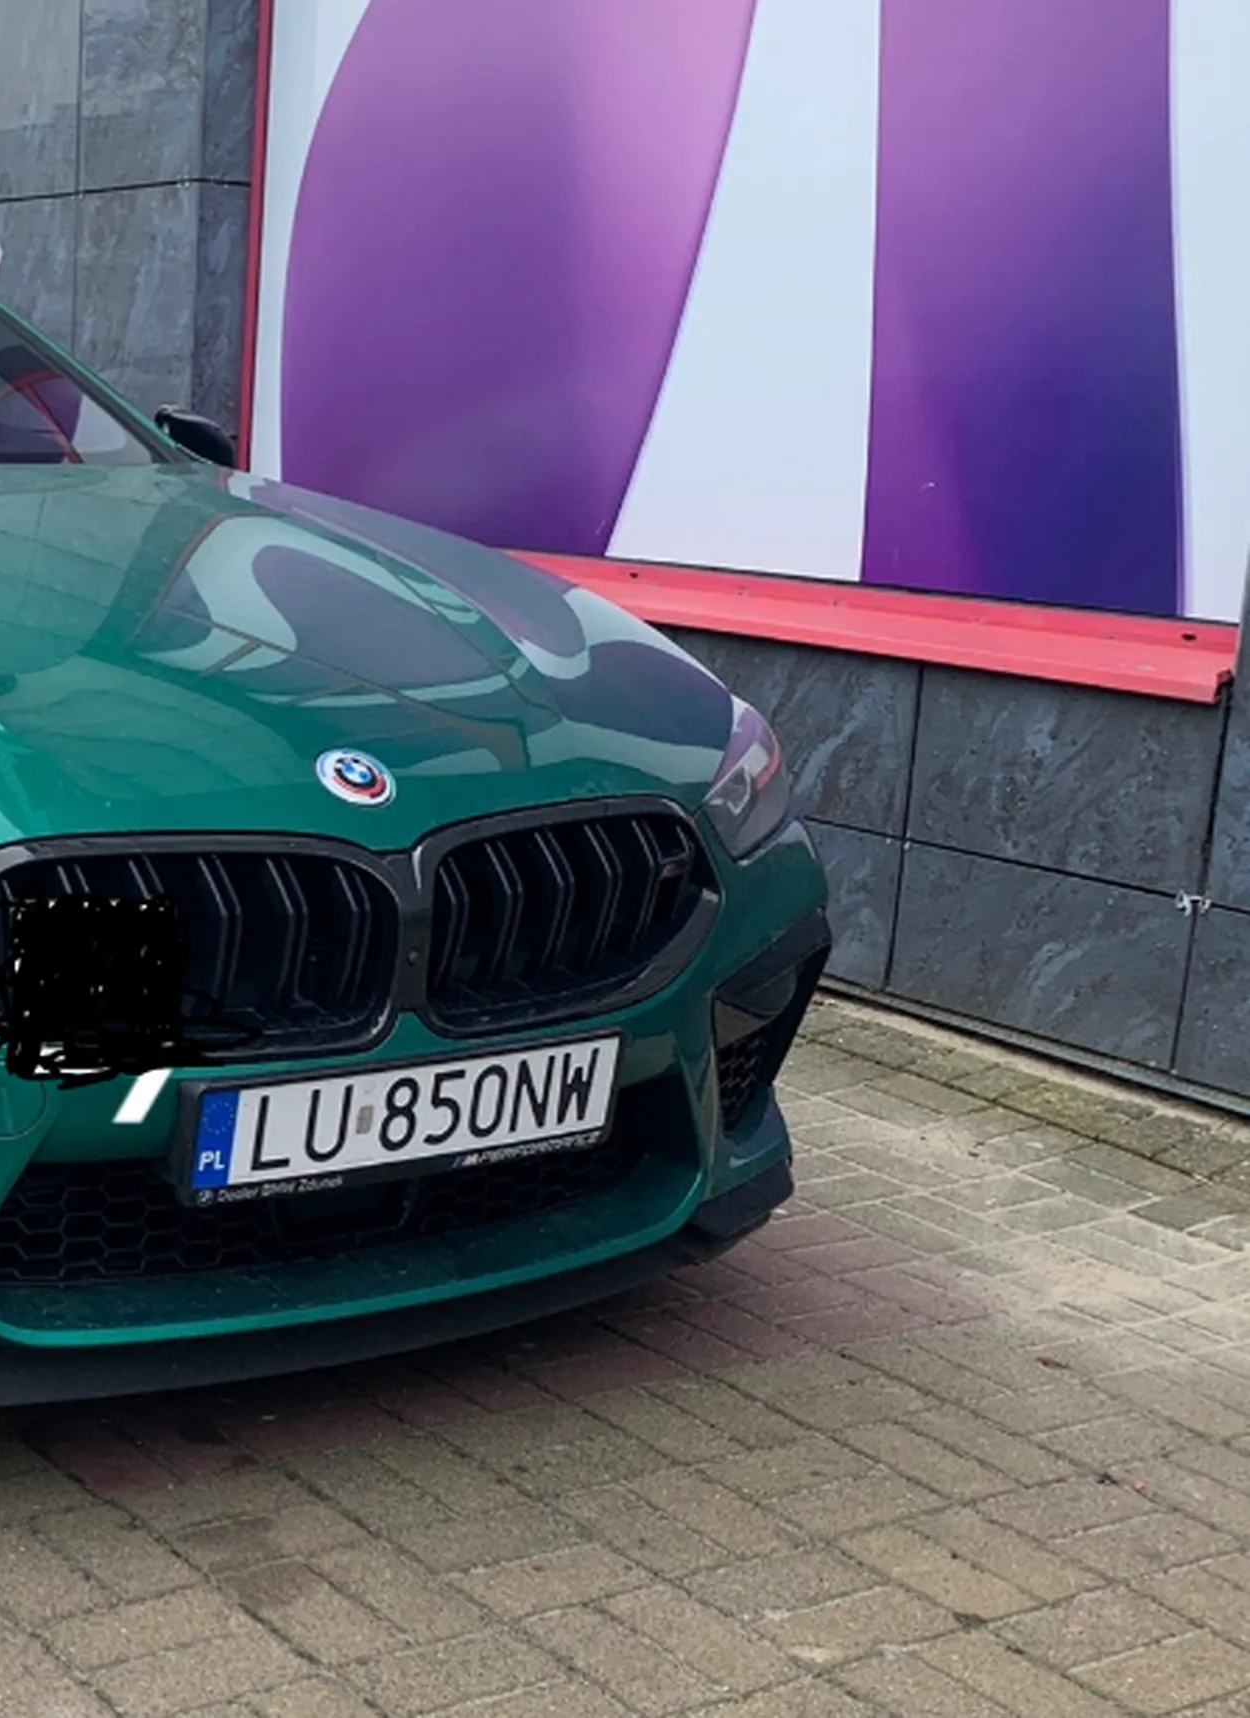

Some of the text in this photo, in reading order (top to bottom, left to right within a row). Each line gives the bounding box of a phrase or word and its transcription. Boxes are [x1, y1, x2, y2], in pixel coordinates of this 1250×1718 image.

[250, 1047, 600, 1171] LU 850NW
[198, 1150, 225, 1171] PL
